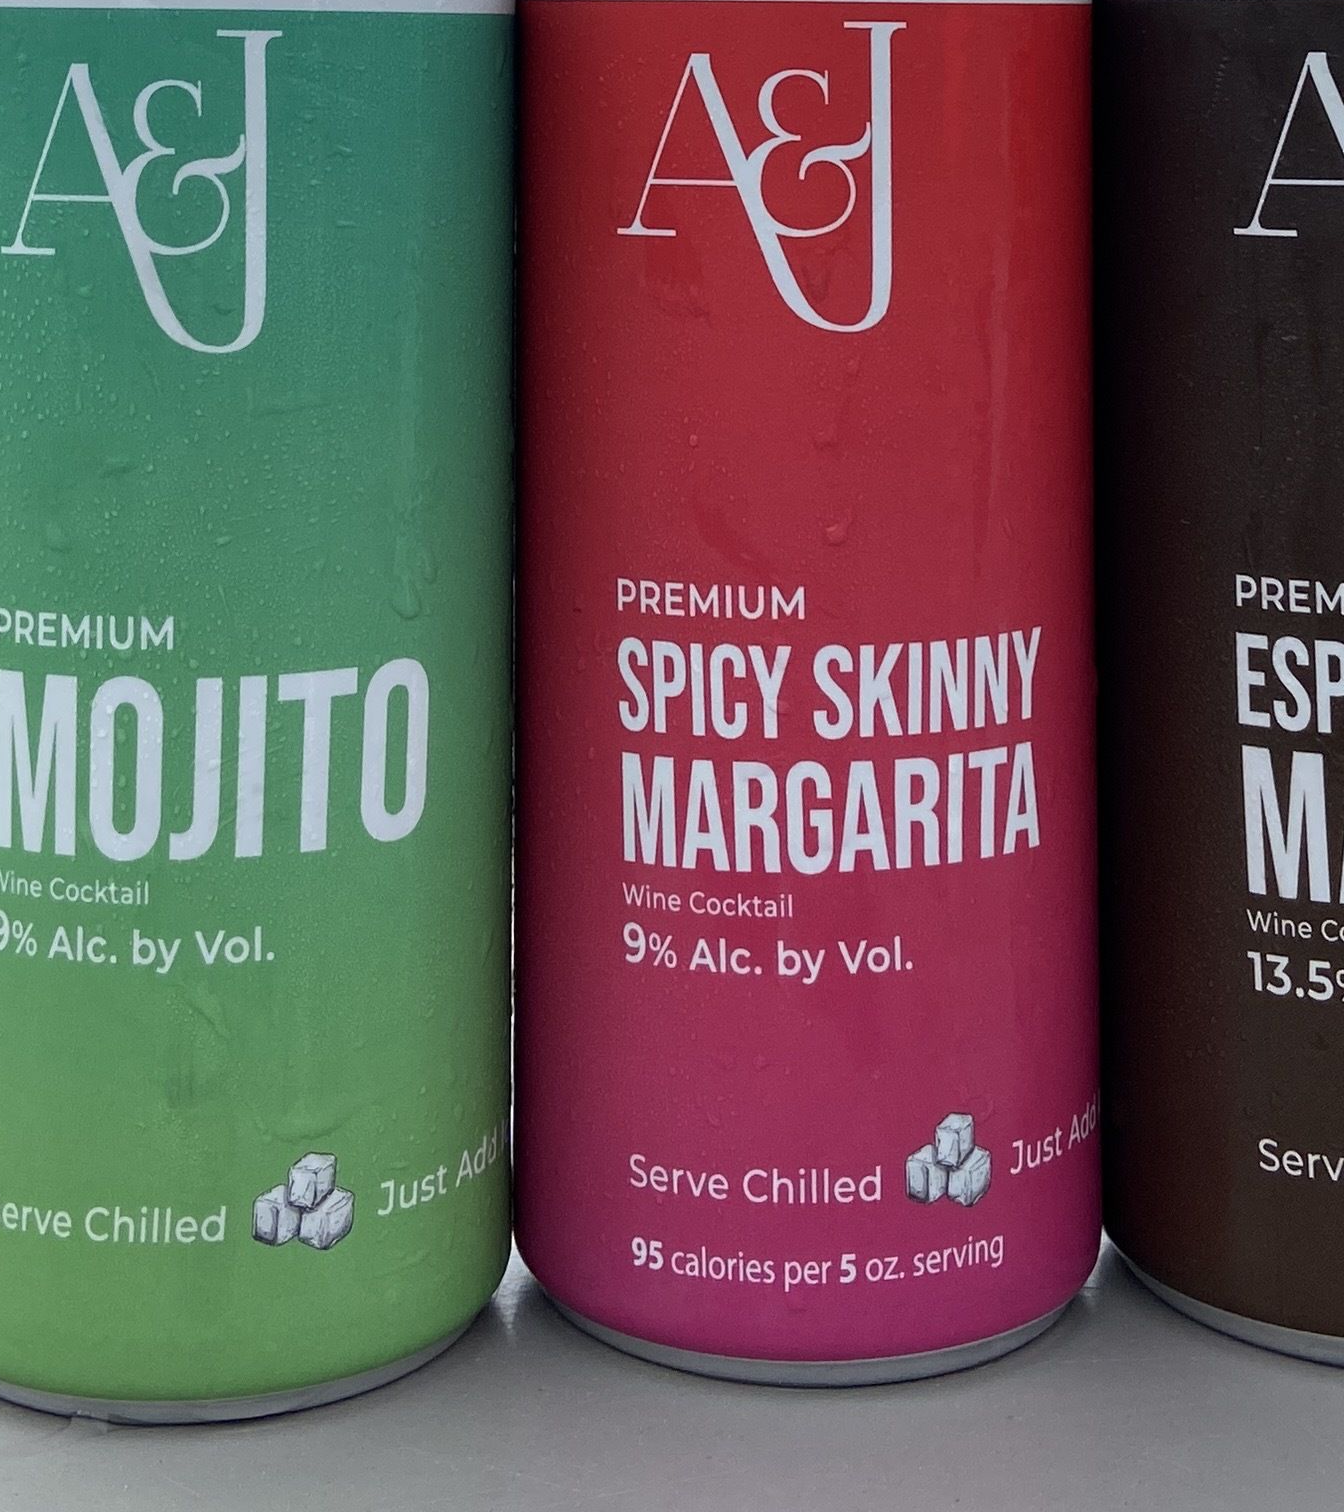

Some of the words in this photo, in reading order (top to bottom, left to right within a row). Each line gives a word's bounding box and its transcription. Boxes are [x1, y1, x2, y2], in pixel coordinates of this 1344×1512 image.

[1, 29, 282, 353] A&J
[616, 21, 907, 333] A&J
[616, 578, 806, 621] PREMIUM
[617, 636, 792, 740] SPICY
[812, 625, 1042, 741] SKINNY
[621, 741, 1040, 875] MARGARITA
[49, 877, 150, 906] Cocktail
[622, 882, 681, 913] Wine
[689, 891, 793, 918] Cocktail
[47, 926, 118, 964] Alc.
[132, 929, 181, 974] by
[195, 926, 275, 965] Vol.
[1246, 908, 1313, 940] Wine
[622, 922, 677, 969] 9%
[689, 939, 762, 976] Alc.
[777, 940, 825, 985] by
[837, 935, 913, 975] Vol.
[377, 1164, 448, 1216] Just
[455, 1125, 497, 1188] Add
[1009, 1126, 1063, 1176] Just
[629, 1153, 729, 1201] Serve
[742, 1165, 882, 1205] Chilled
[84, 1206, 226, 1243] Chilled
[631, 1236, 663, 1272] 95
[671, 1245, 775, 1285] calories
[784, 1257, 832, 1292] per
[839, 1254, 857, 1284] 5
[865, 1254, 904, 1282] oz.
[912, 1234, 1004, 1277] serving
